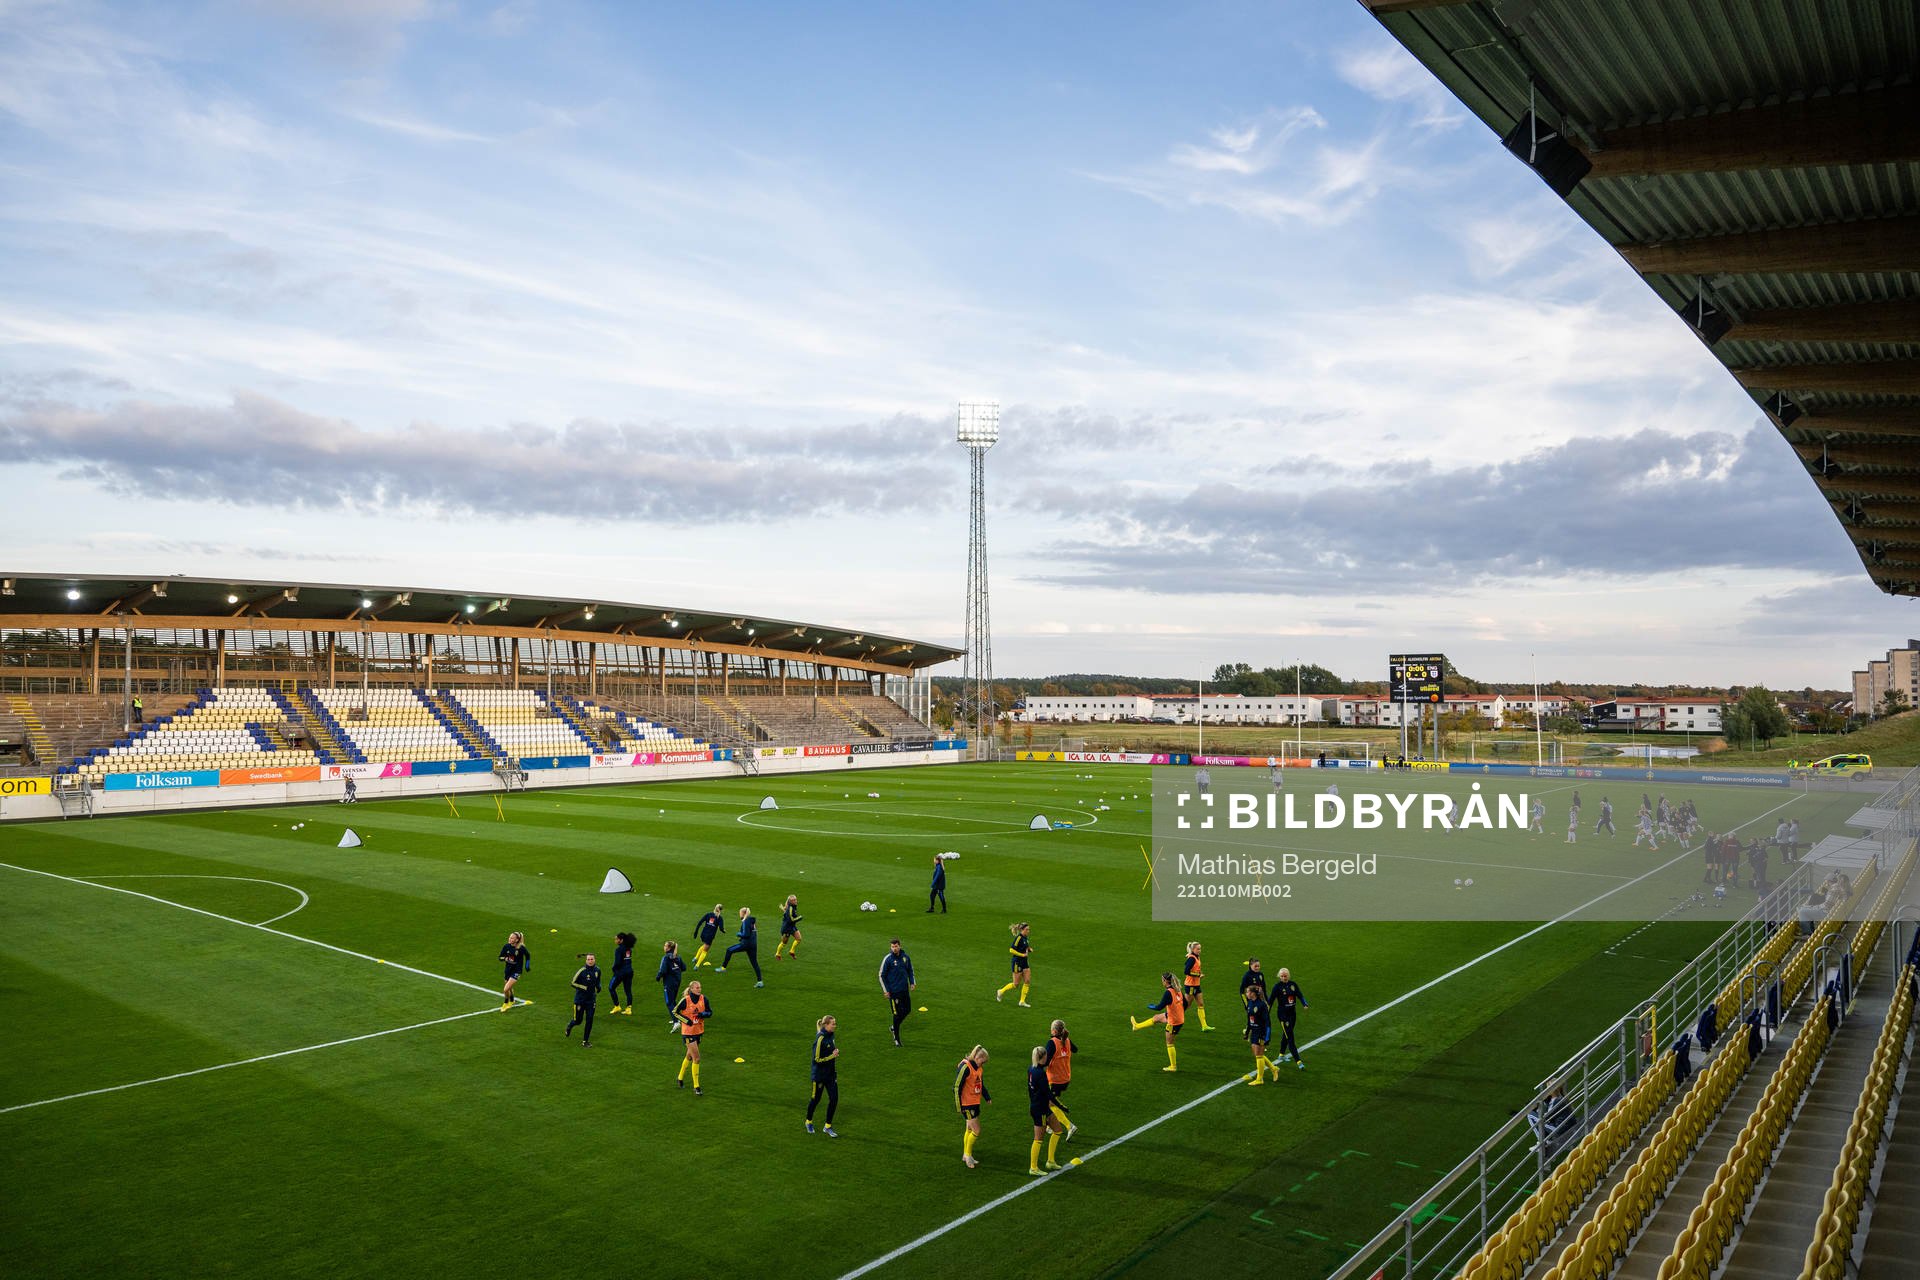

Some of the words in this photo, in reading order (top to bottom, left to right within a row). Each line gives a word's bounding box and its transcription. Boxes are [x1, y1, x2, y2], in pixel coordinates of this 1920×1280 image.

[808, 746, 847, 755] BAUHAUS
[852, 744, 891, 754] CAVALIERE
[1068, 753, 1080, 761] ICA
[1084, 753, 1095, 761] ICA
[1099, 754, 1111, 762] ICA
[1205, 757, 1235, 766] Folksam
[250, 771, 283, 779] Swedbank
[136, 775, 192, 788] Folksam
